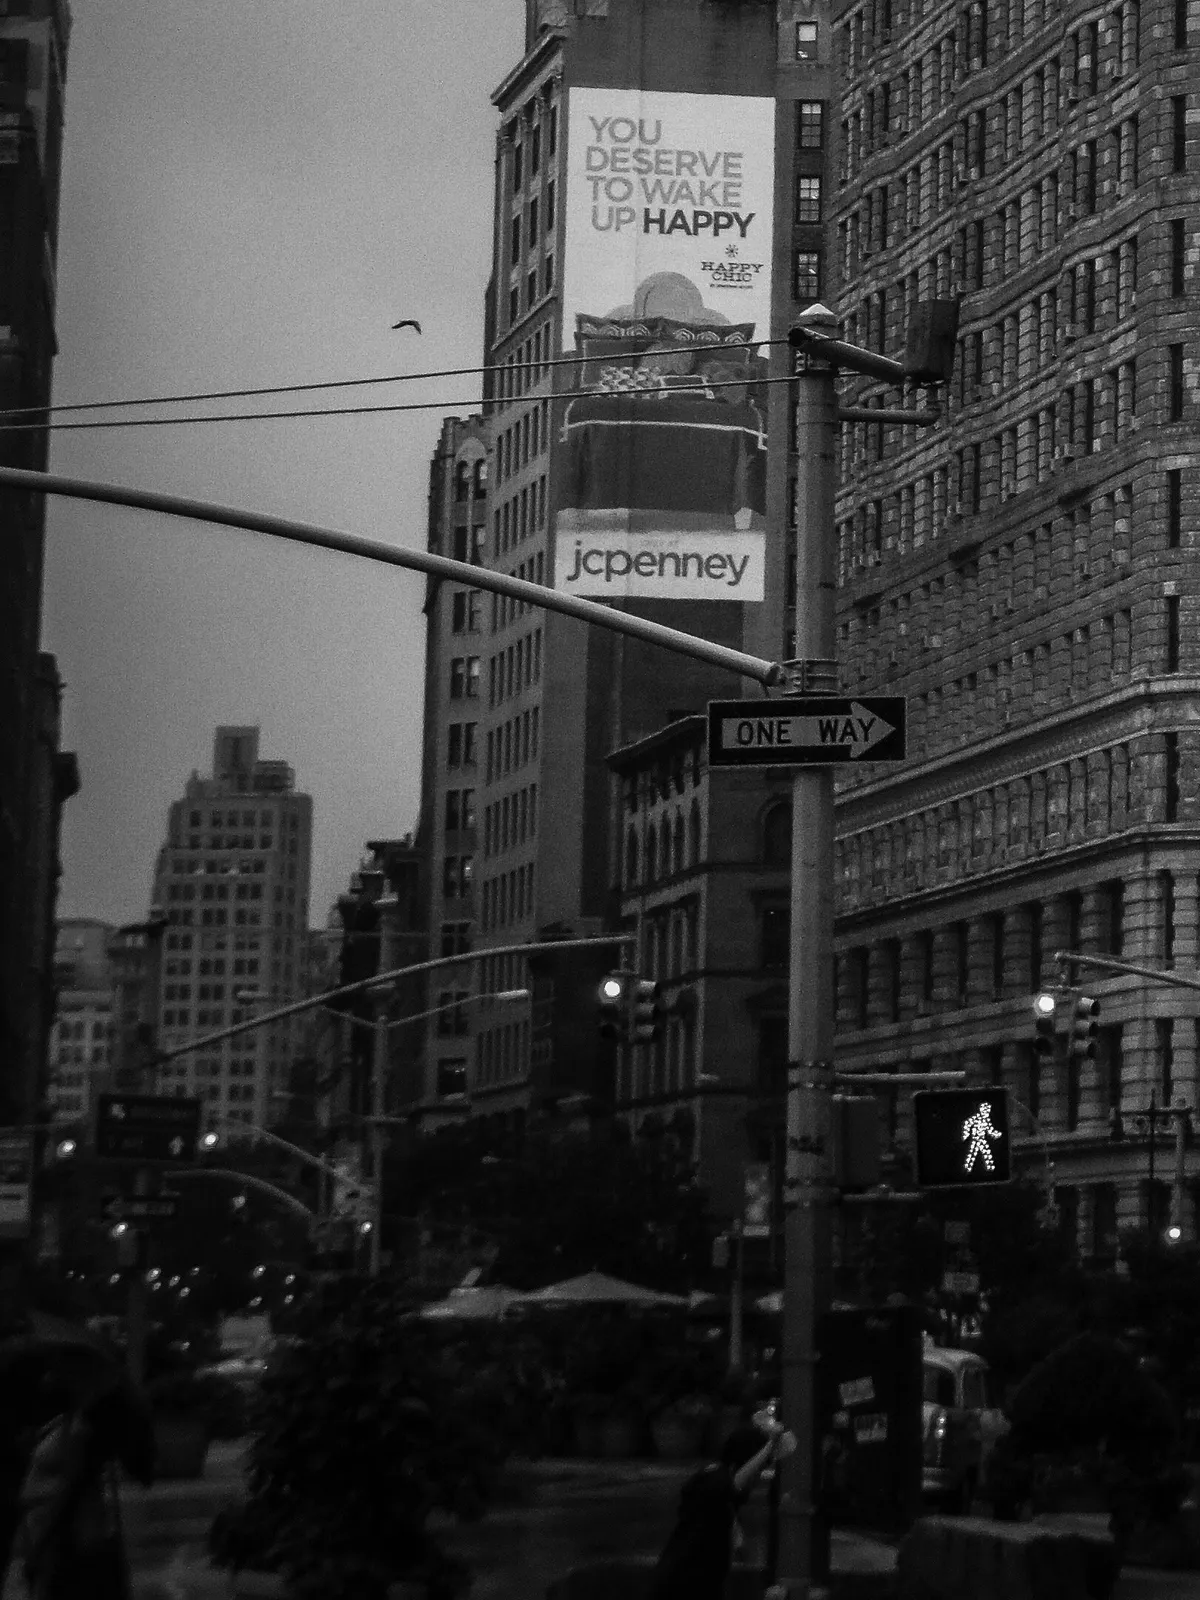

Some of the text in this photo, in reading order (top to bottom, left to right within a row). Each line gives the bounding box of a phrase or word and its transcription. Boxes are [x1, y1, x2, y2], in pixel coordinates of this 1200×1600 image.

[588, 115, 662, 145] YOU
[585, 146, 743, 178] DESERVE
[586, 175, 742, 208] TO WAKE
[591, 205, 756, 238] UP HAPPY
[701, 261, 764, 274] HAPPY
[711, 272, 752, 282] CHIC
[566, 540, 750, 587] jcpenney
[737, 717, 876, 745] ONE WAY
